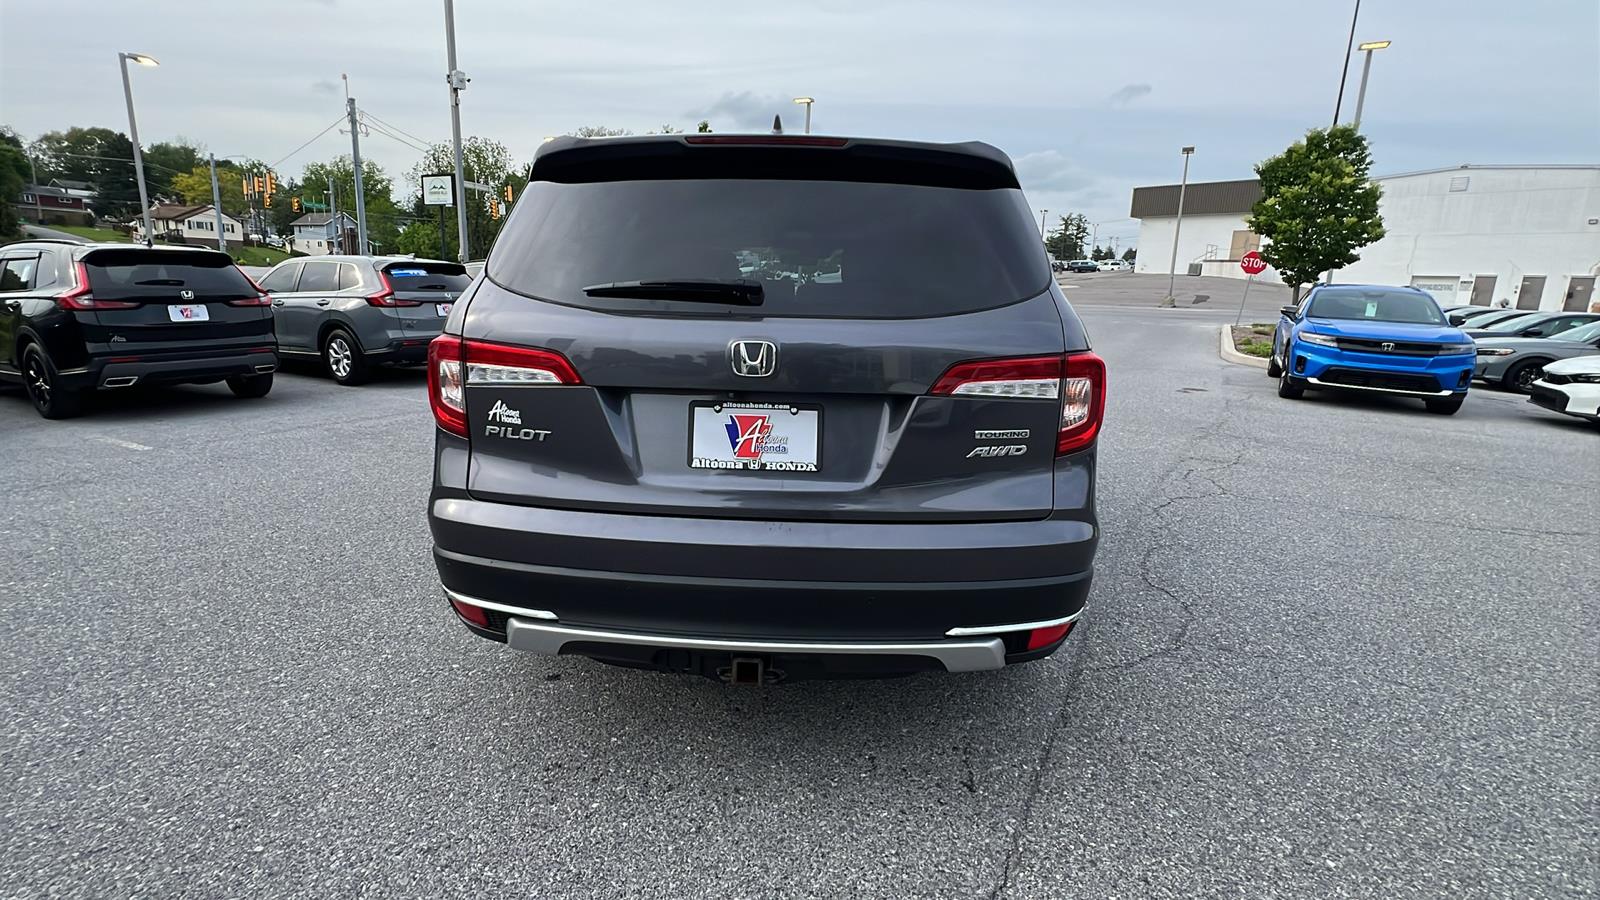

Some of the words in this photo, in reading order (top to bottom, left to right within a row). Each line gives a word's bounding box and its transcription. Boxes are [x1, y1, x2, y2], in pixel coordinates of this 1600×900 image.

[722, 402, 790, 410] altoonahonda.com
[501, 414, 522, 425] Honda
[485, 425, 552, 441] PILOT
[976, 430, 1029, 438] TOURING
[756, 443, 788, 453] Honda
[966, 444, 1028, 458] AWD
[691, 457, 743, 469] Altoona
[765, 461, 818, 472] HONDA
